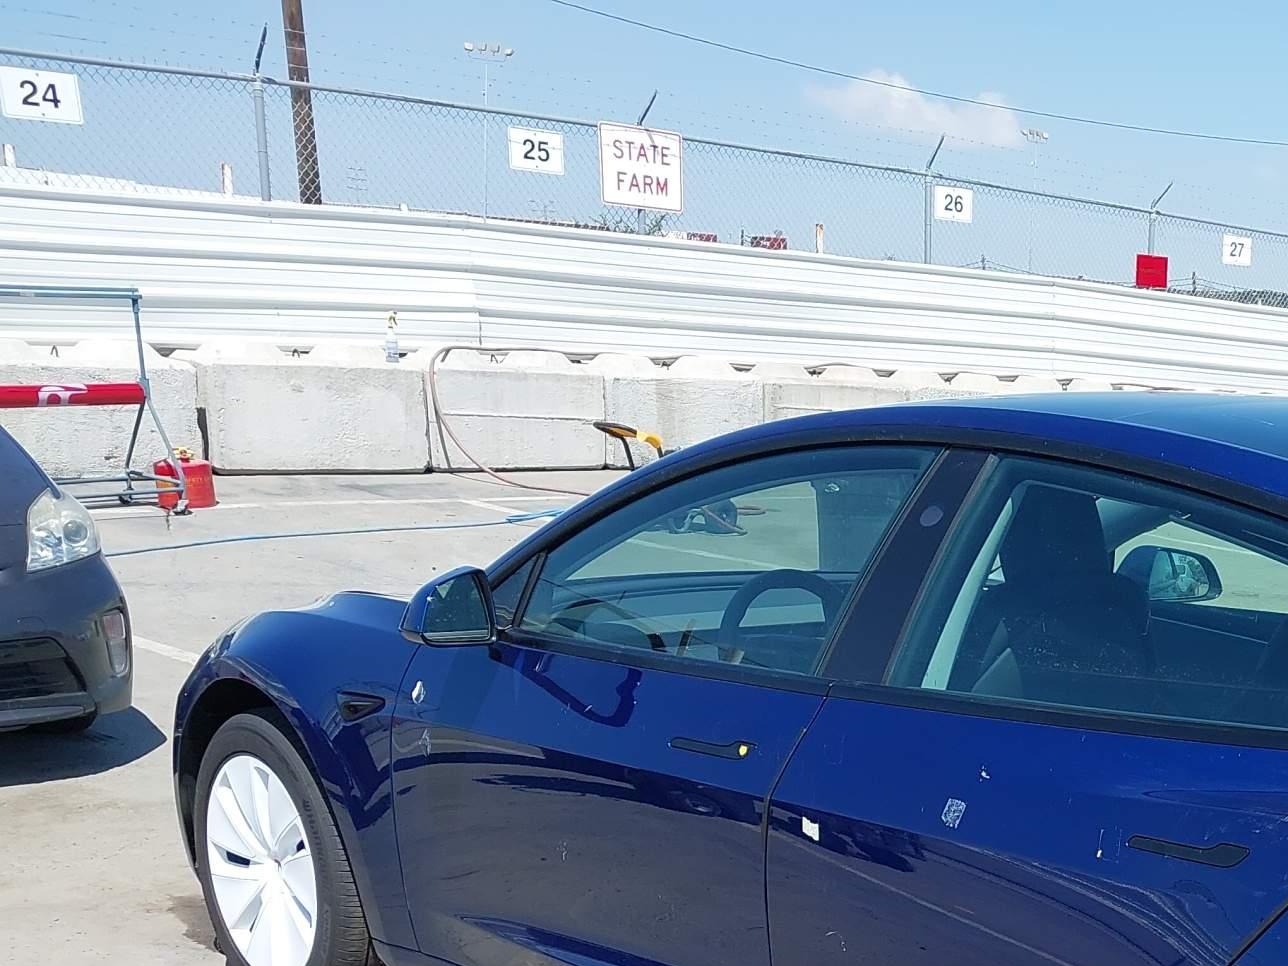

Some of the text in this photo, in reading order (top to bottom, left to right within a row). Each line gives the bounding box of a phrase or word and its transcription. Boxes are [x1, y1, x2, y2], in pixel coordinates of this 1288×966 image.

[19, 80, 61, 109] 24
[522, 139, 550, 162] 25
[612, 139, 672, 166] STATE
[616, 171, 669, 197] FARM
[944, 193, 964, 213] 26
[1229, 241, 1245, 257] 27
